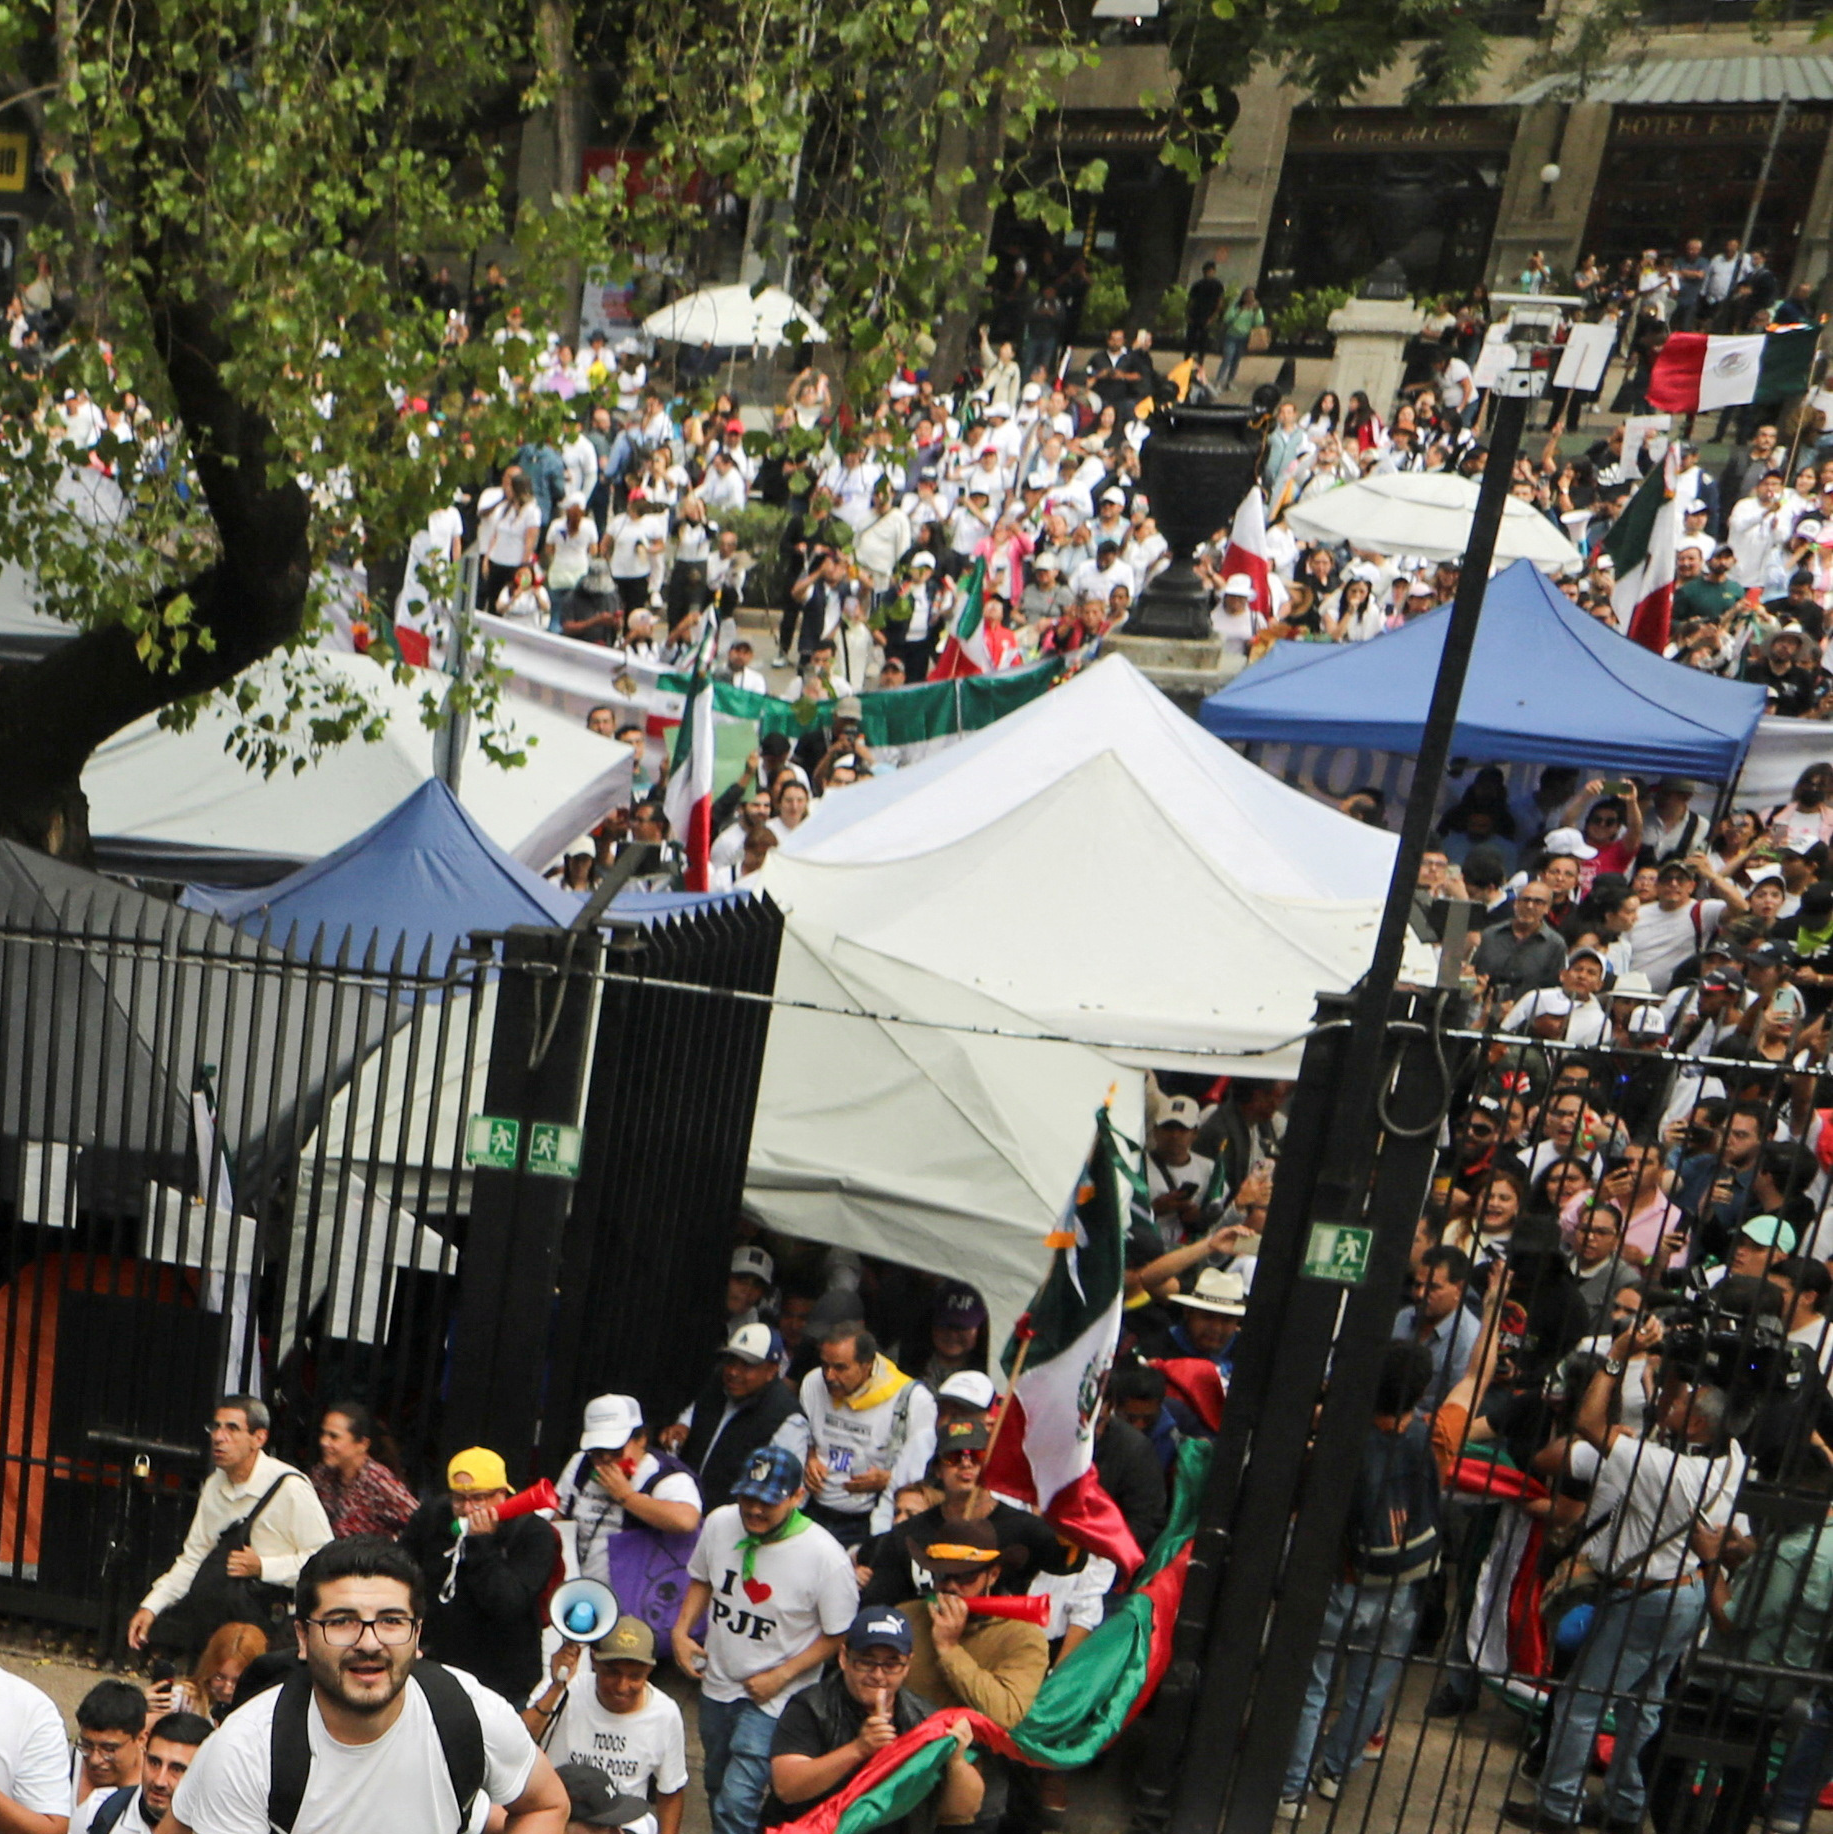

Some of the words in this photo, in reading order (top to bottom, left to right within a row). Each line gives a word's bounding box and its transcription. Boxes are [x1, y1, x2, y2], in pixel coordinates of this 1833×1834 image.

[720, 1568, 738, 1596] I
[712, 1597, 777, 1641] PJF
[594, 1732, 626, 1753] TODOS
[606, 1758, 638, 1777] PODER
